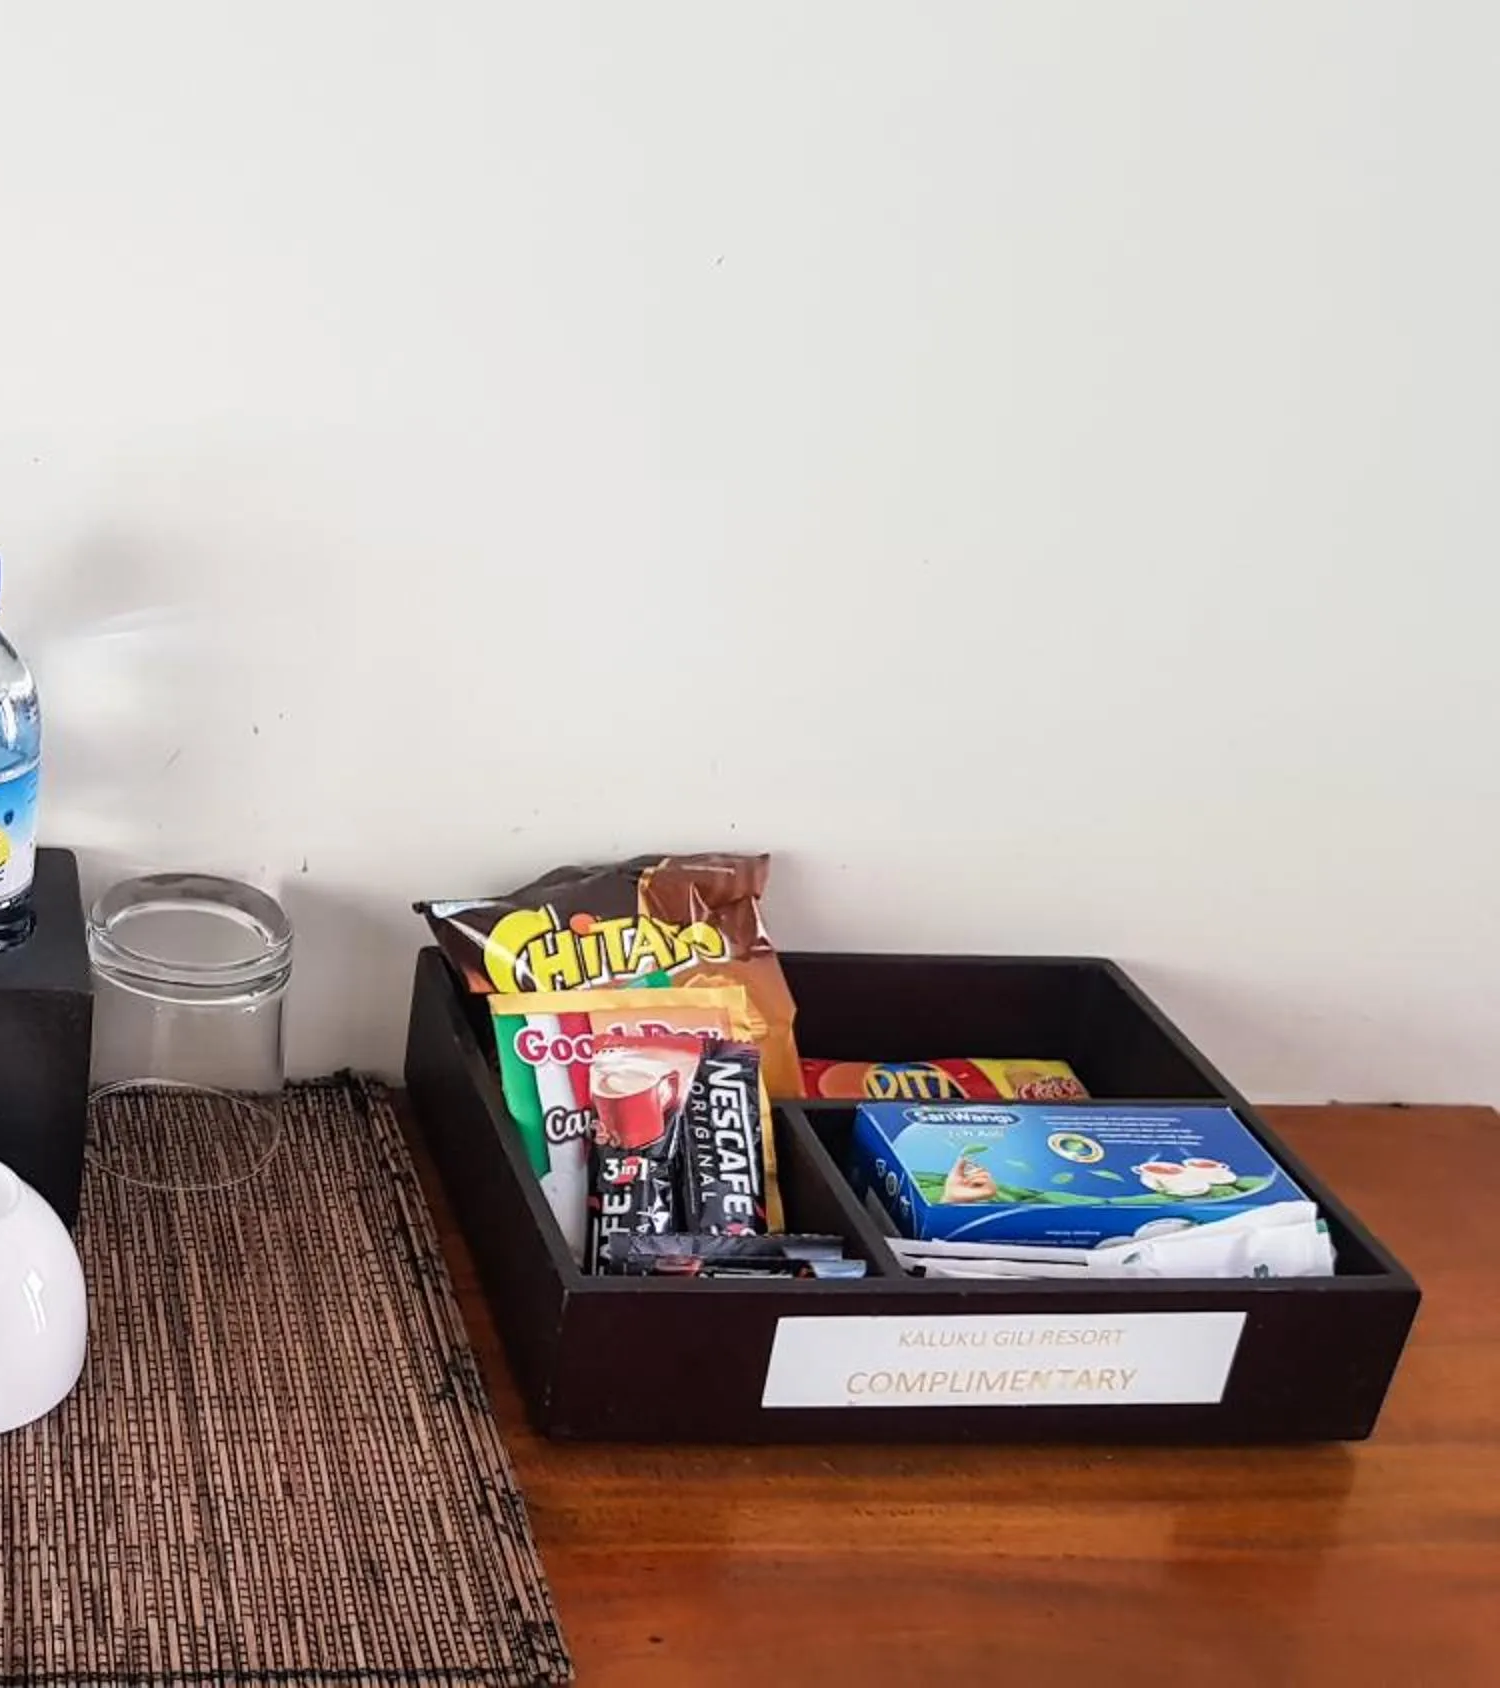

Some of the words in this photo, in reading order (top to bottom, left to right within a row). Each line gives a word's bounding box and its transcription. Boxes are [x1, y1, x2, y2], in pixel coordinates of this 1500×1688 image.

[691, 1082, 717, 1202] ORIGINAL
[899, 1330, 987, 1348] KALUKU
[993, 1329, 1034, 1347] GILI
[1040, 1329, 1126, 1346] RESORT
[846, 1369, 1139, 1395] COMPLIMENTARY
